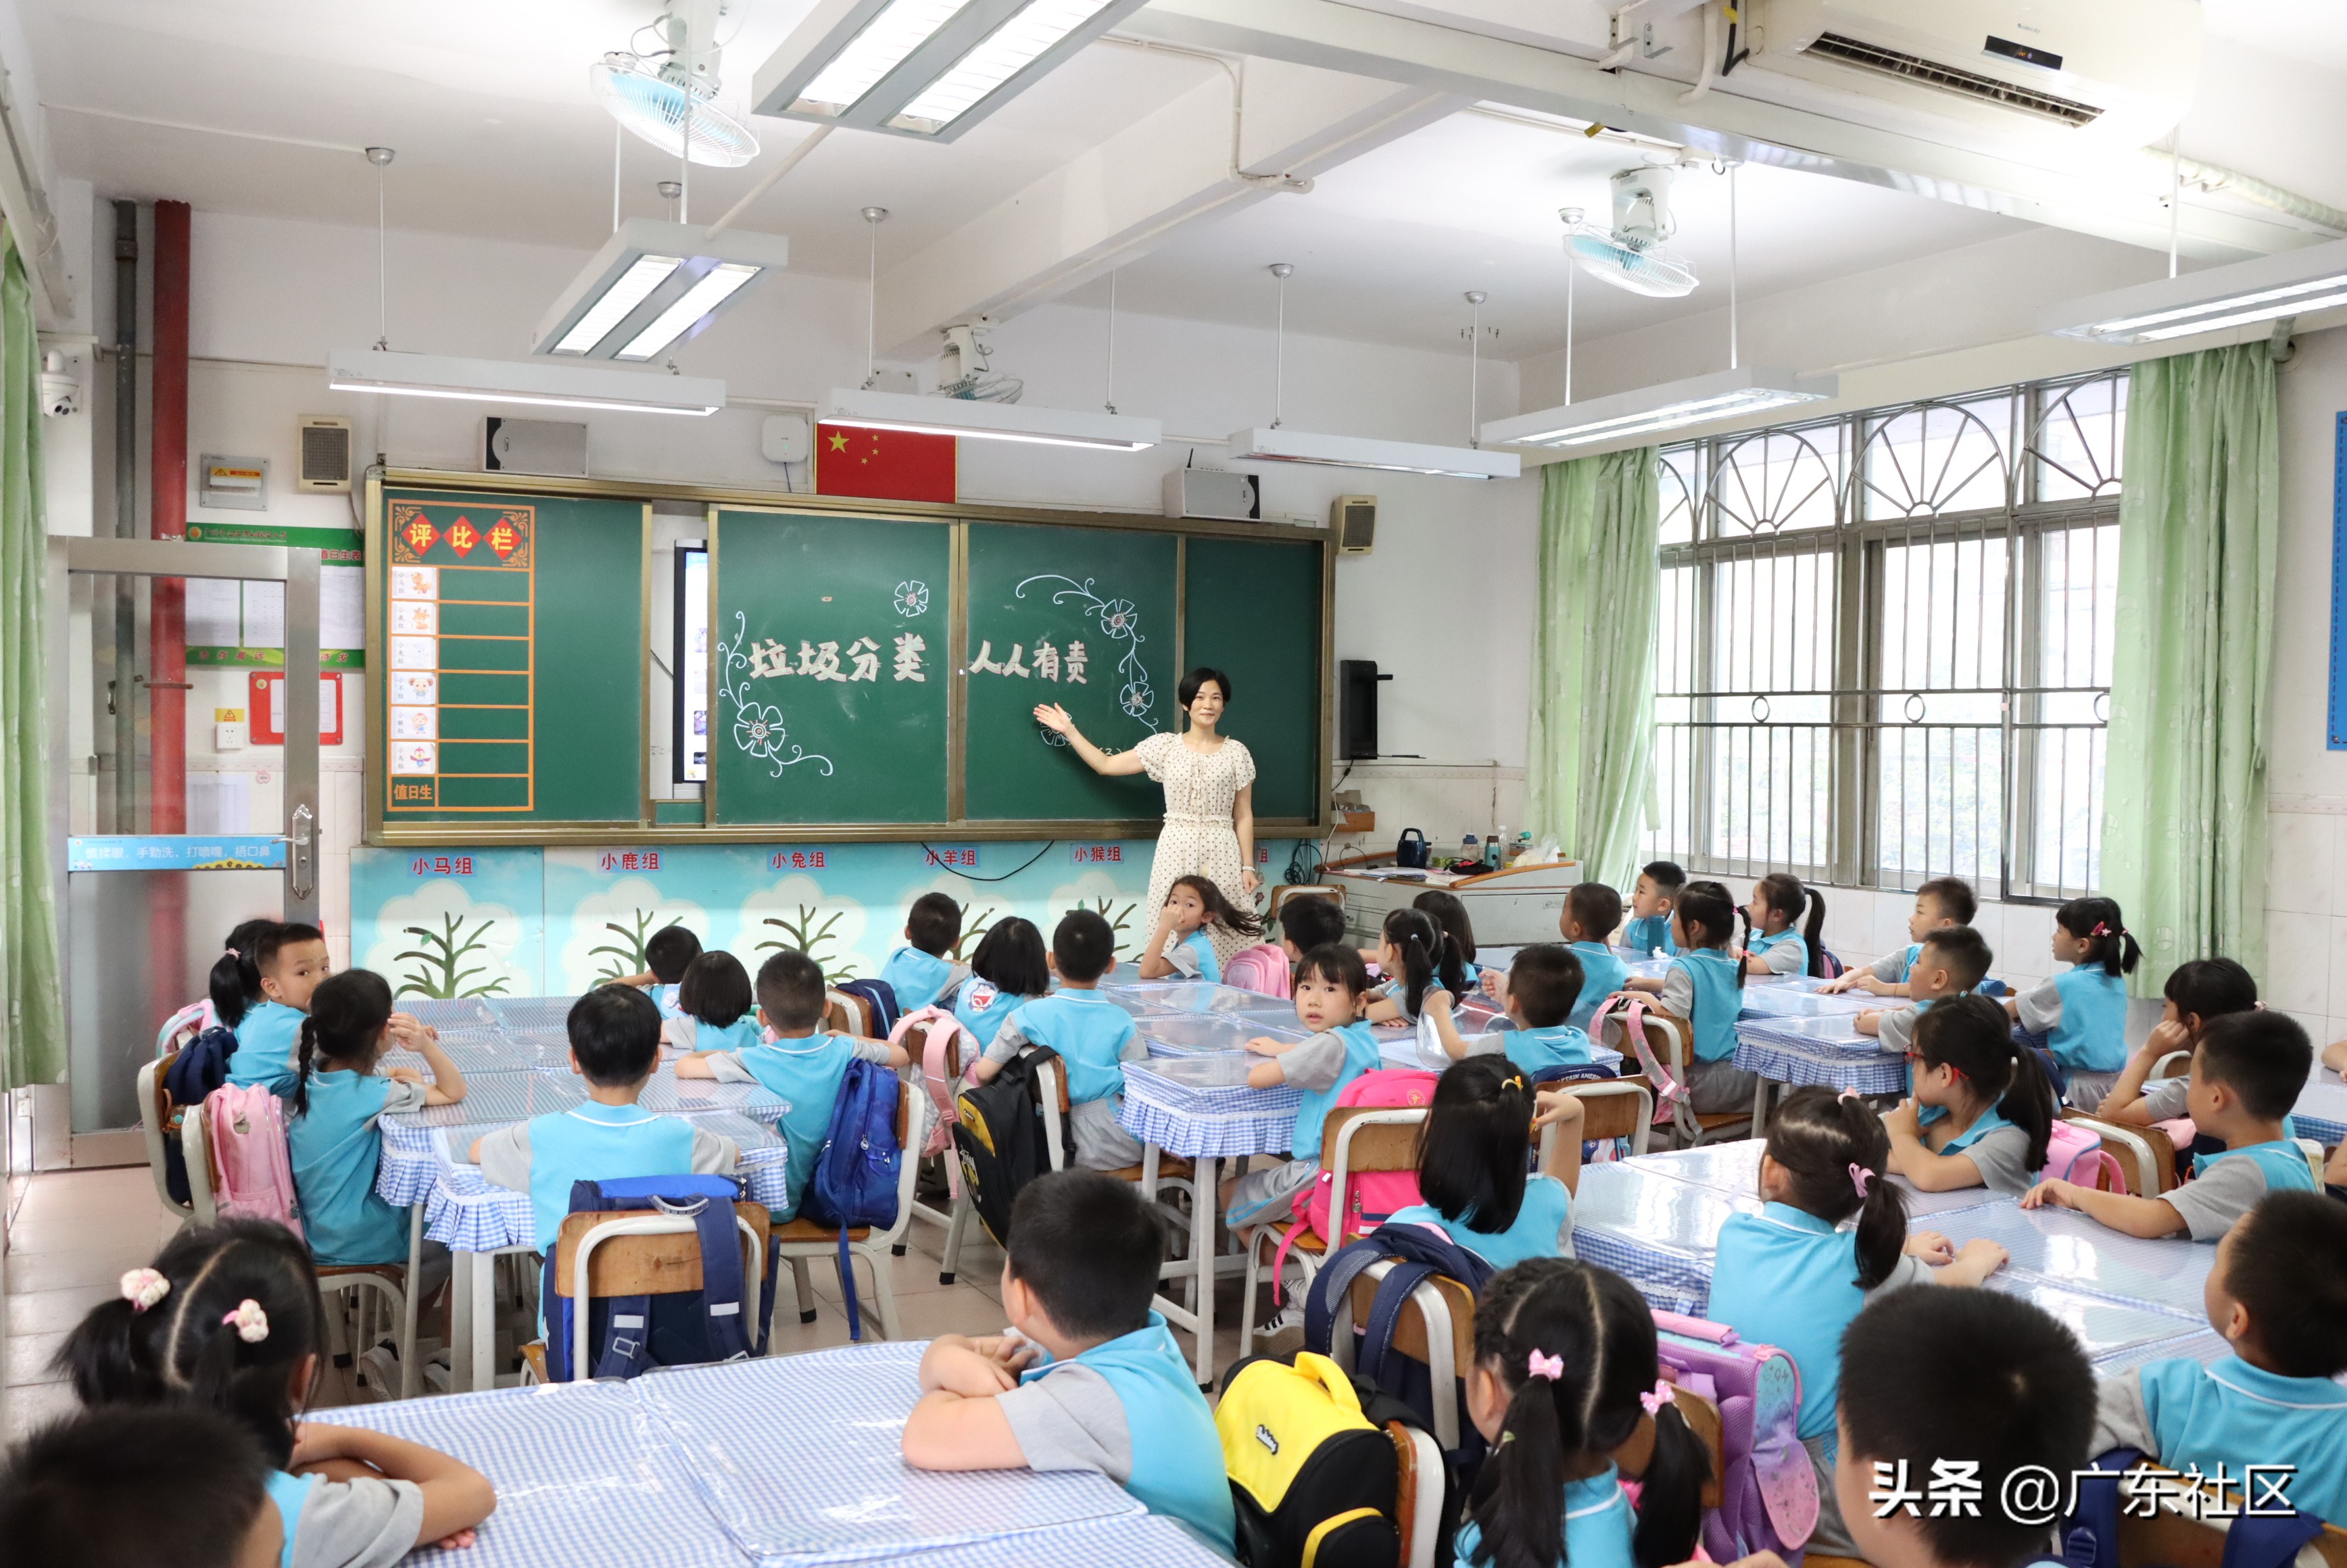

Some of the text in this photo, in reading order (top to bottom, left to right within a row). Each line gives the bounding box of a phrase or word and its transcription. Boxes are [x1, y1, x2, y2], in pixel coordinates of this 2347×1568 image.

[410, 523, 513, 550] 评比栏
[748, 633, 1088, 683] 垃圾分类 人人有责
[393, 784, 433, 800] 值日生
[601, 852, 660, 871] 小鹿组
[772, 851, 826, 869] 小兔组
[926, 849, 976, 866] 小羊组
[1075, 846, 1121, 862] 小猴组
[412, 856, 473, 875] 小马组
[1580, 1073, 1601, 1081] AMERIC
